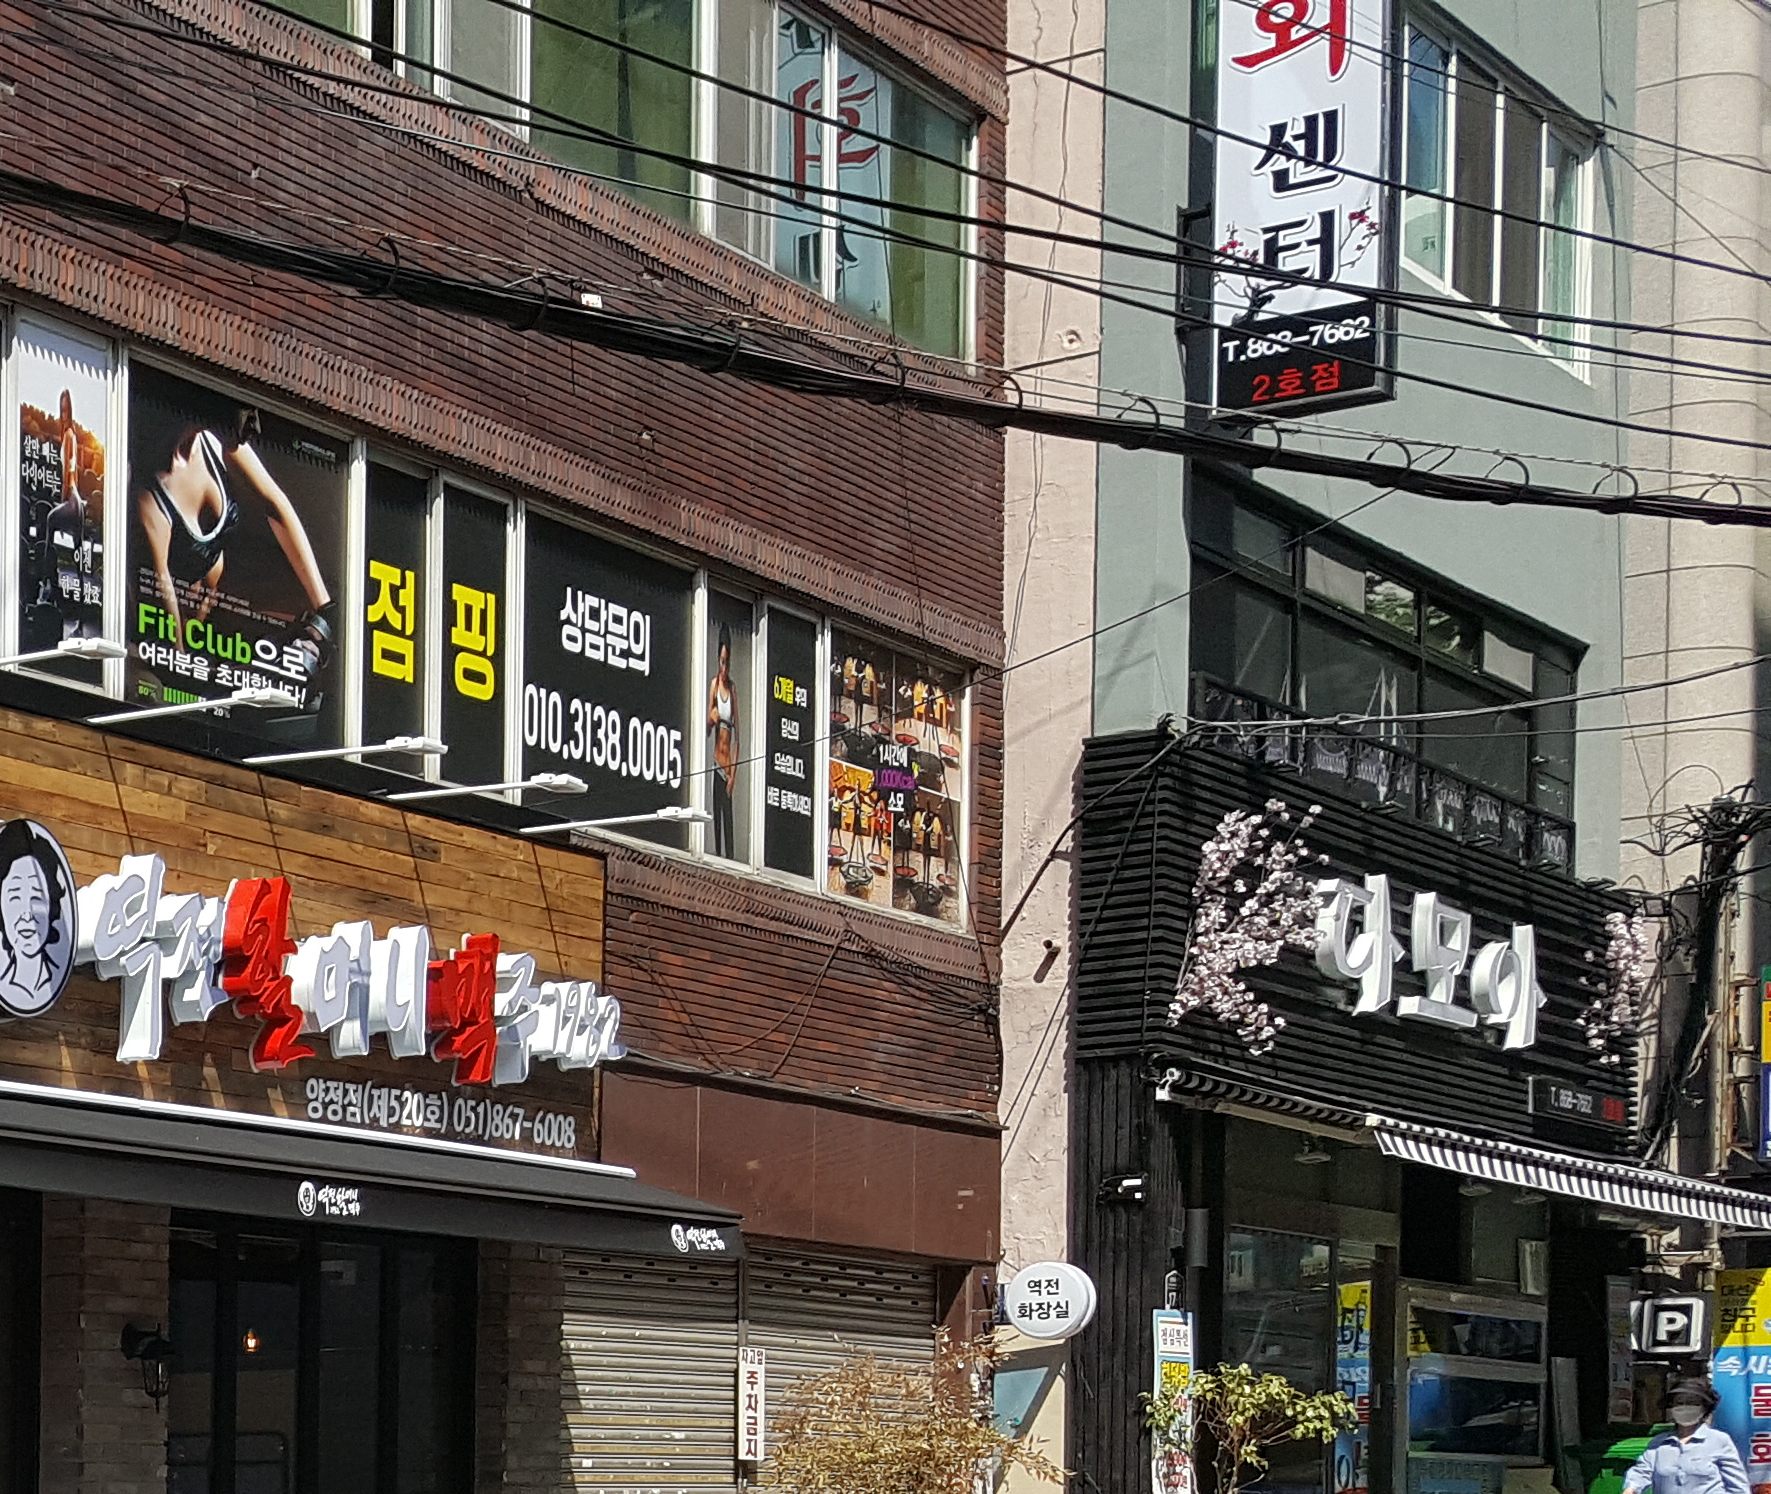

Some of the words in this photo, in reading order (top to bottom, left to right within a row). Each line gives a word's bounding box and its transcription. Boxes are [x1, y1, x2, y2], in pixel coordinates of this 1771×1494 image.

[1250, 361, 1341, 403] 2호점
[138, 602, 177, 643] Fit
[559, 586, 651, 677] 상담문의
[138, 641, 209, 682] 여러분을
[523, 683, 682, 789] 010.3138.0005
[888, 791, 905, 812] 소모
[305, 1076, 448, 1133] 양정점(제520호)
[452, 1094, 576, 1150] 051)867-6008
[1026, 1278, 1061, 1297] 역전
[1016, 1301, 1070, 1321] 화장실
[1658, 1310, 1689, 1341] P
[1721, 1307, 1757, 1324] 친구
[1716, 1355, 1771, 1377] 속시
[744, 1372, 759, 1458] 주차금지
